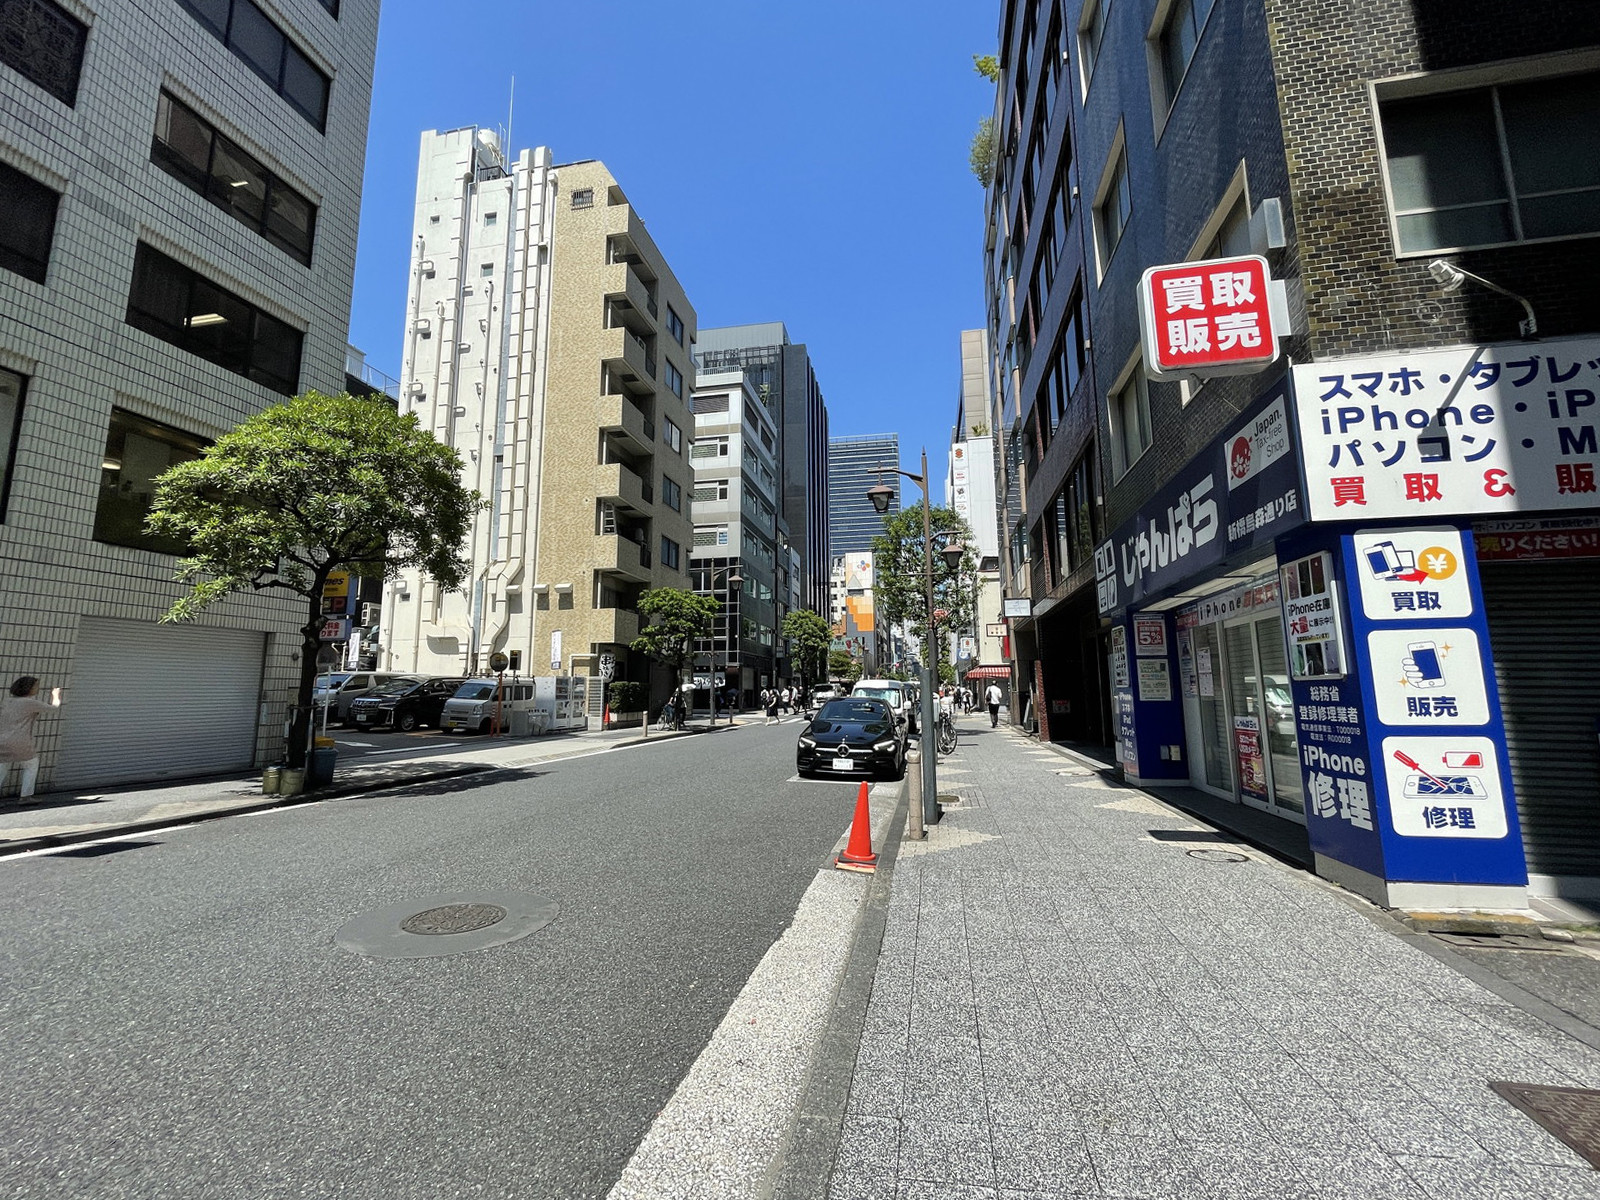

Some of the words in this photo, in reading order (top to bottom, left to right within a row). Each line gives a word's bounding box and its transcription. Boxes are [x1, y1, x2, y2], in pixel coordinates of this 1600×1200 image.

[1162, 271, 1256, 314] 買取
[1167, 312, 1262, 355] 販売
[1254, 409, 1282, 437] Japan.
[1255, 424, 1282, 450] Tax-free
[1267, 438, 1284, 457] Shop
[1122, 473, 1218, 587] じゃんぱら
[1475, 533, 1598, 552] 売りください!
[1200, 597, 1241, 620] iPhone
[1288, 598, 1331, 617] iPhone在庫
[1391, 591, 1442, 612] 買取
[1310, 686, 1340, 702] 総務省
[1299, 705, 1358, 724] 登録修理業者
[1406, 696, 1458, 717] 販売
[1303, 745, 1366, 776] iPhone
[1308, 770, 1374, 831] 修理
[1422, 807, 1476, 830] 修理
